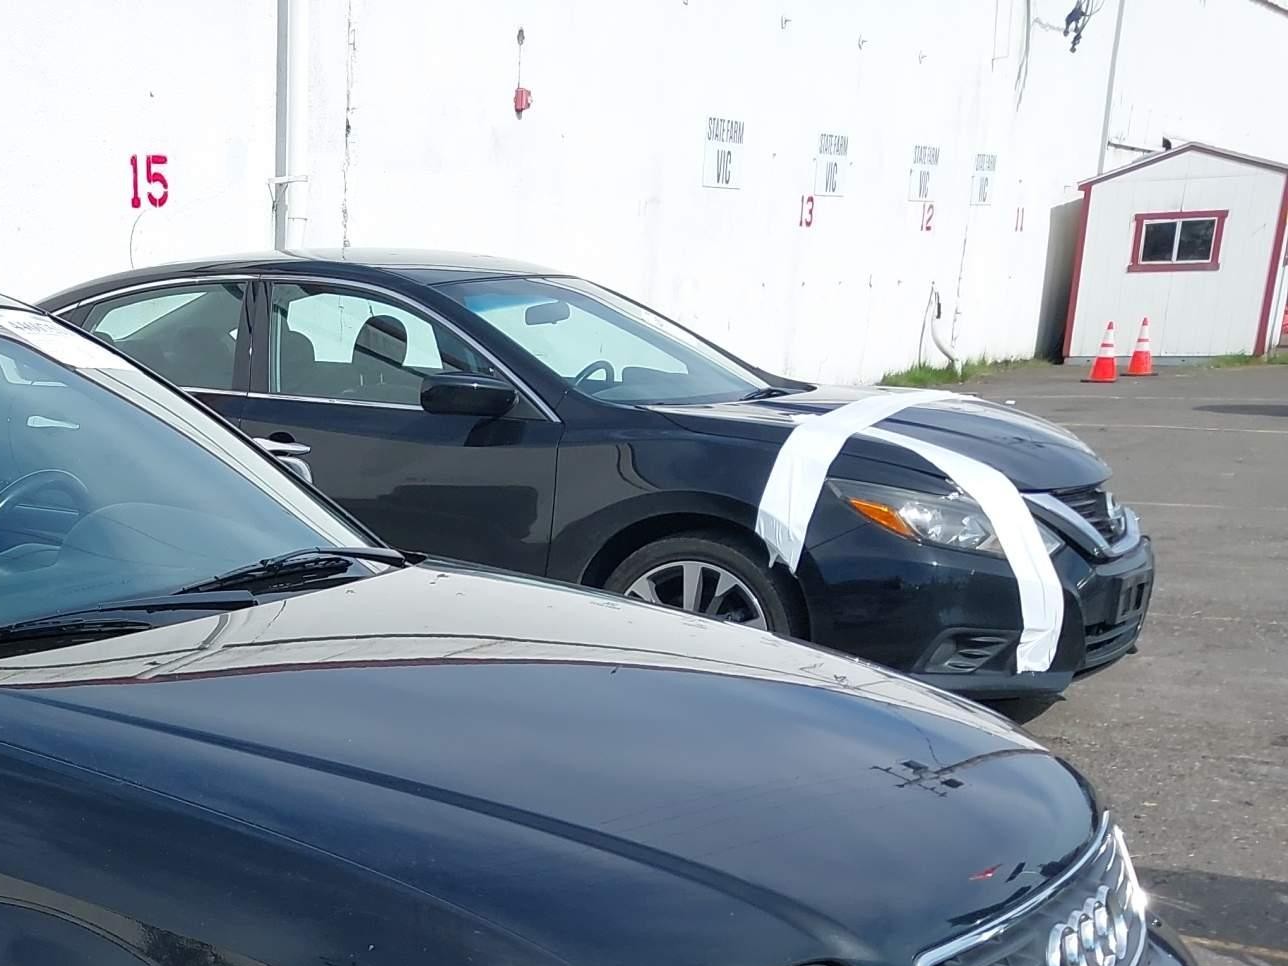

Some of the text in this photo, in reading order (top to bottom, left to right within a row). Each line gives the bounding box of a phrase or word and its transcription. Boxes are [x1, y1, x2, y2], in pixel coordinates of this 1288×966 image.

[707, 116, 745, 145] STATE FARM
[819, 132, 849, 157] STATE FARM
[716, 148, 732, 185] VIC
[825, 161, 838, 193] VIC
[129, 154, 169, 209] 15
[918, 170, 930, 199] VIC
[799, 194, 815, 228] 13
[920, 203, 935, 232] 12
[1015, 207, 1025, 233] 11
